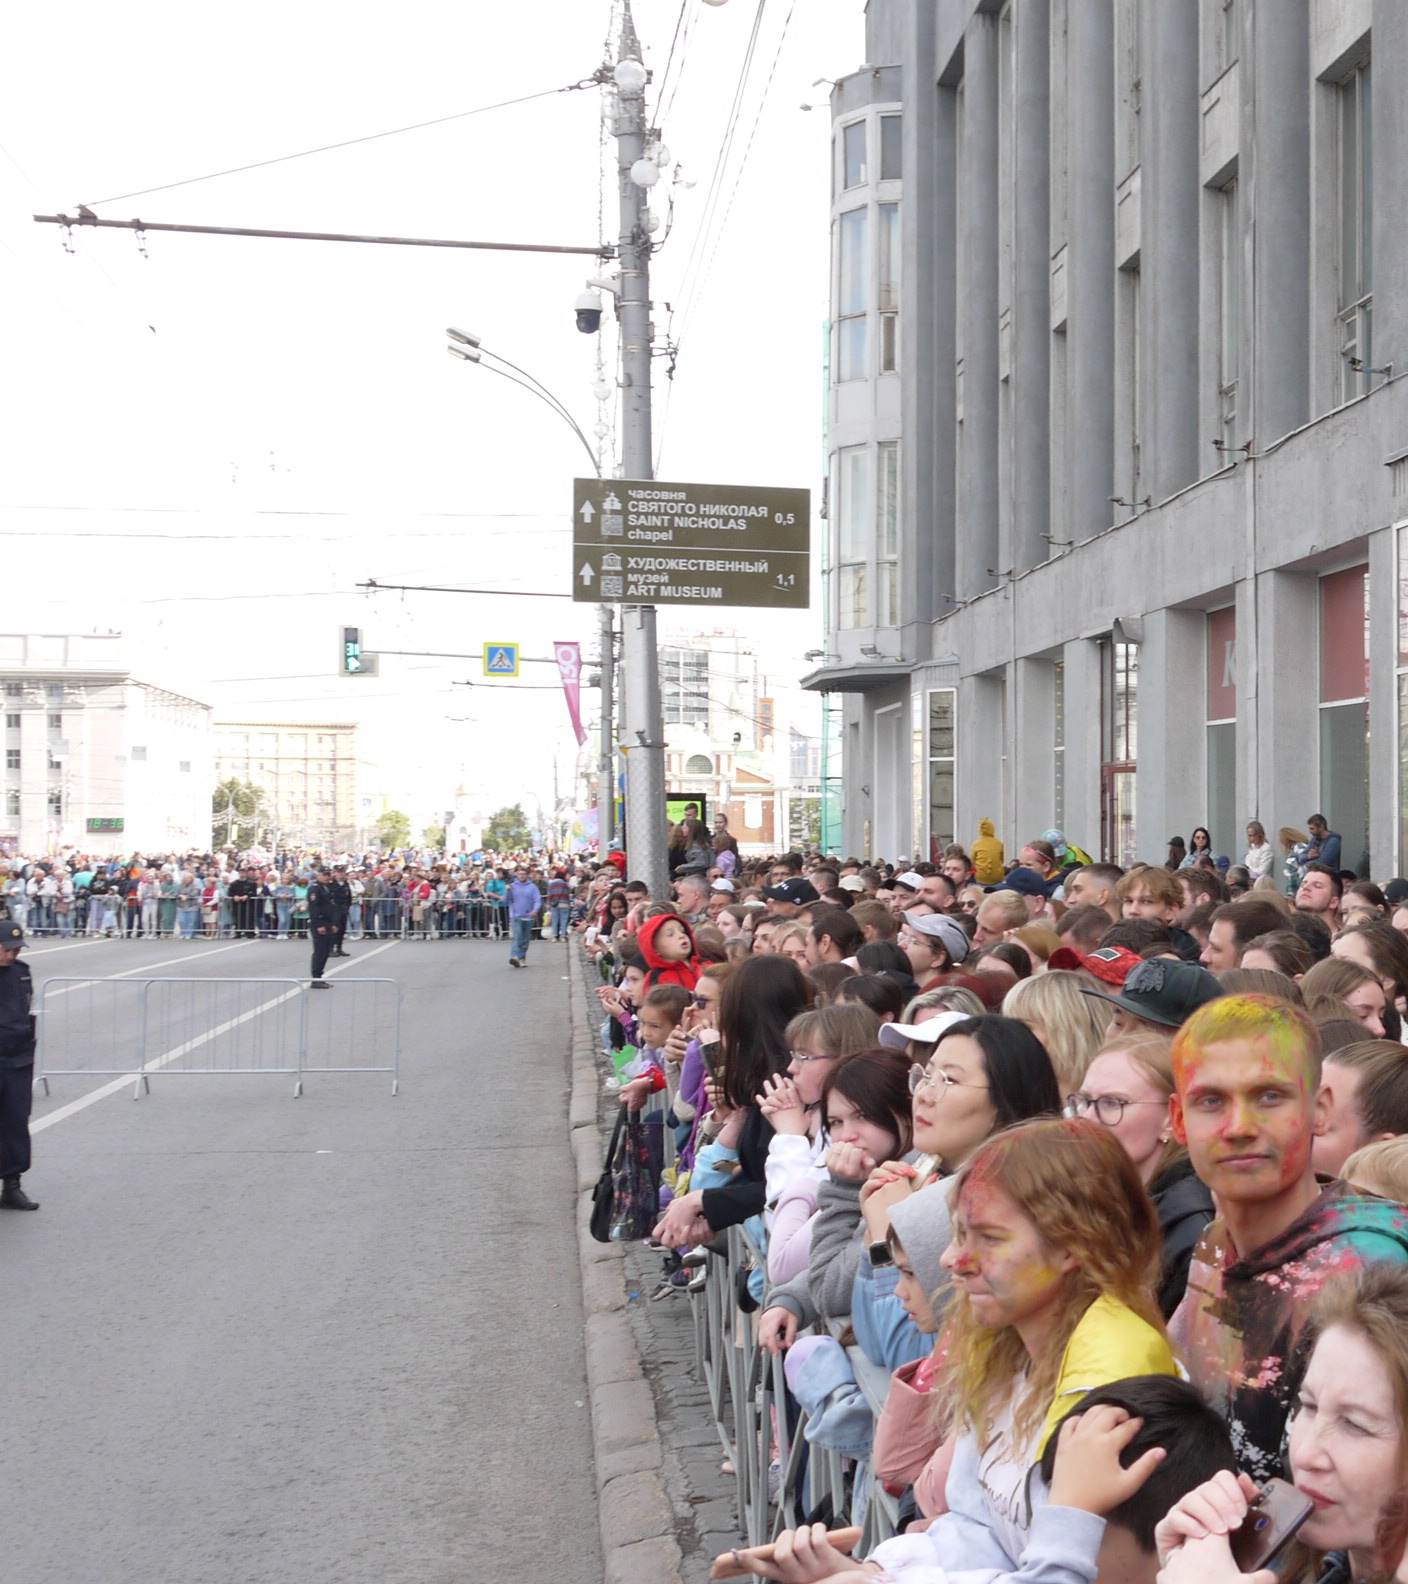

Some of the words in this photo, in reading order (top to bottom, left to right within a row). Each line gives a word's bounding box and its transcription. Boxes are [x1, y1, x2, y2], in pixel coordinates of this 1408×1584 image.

[628, 489, 687, 500] часовня
[628, 501, 696, 514] СВЯТОГО
[700, 504, 768, 517] НИКОЛАЯ
[627, 515, 670, 527] SAINT
[674, 517, 747, 530] NICHOLAS
[775, 513, 795, 526] 0,5
[628, 529, 673, 542] chapel
[627, 556, 769, 573] ХУДОЖЕСТВЕННЫЙ
[627, 572, 669, 584] музей
[776, 574, 795, 586] 1,1
[627, 585, 656, 597] ART
[660, 586, 723, 599] MUSEUM
